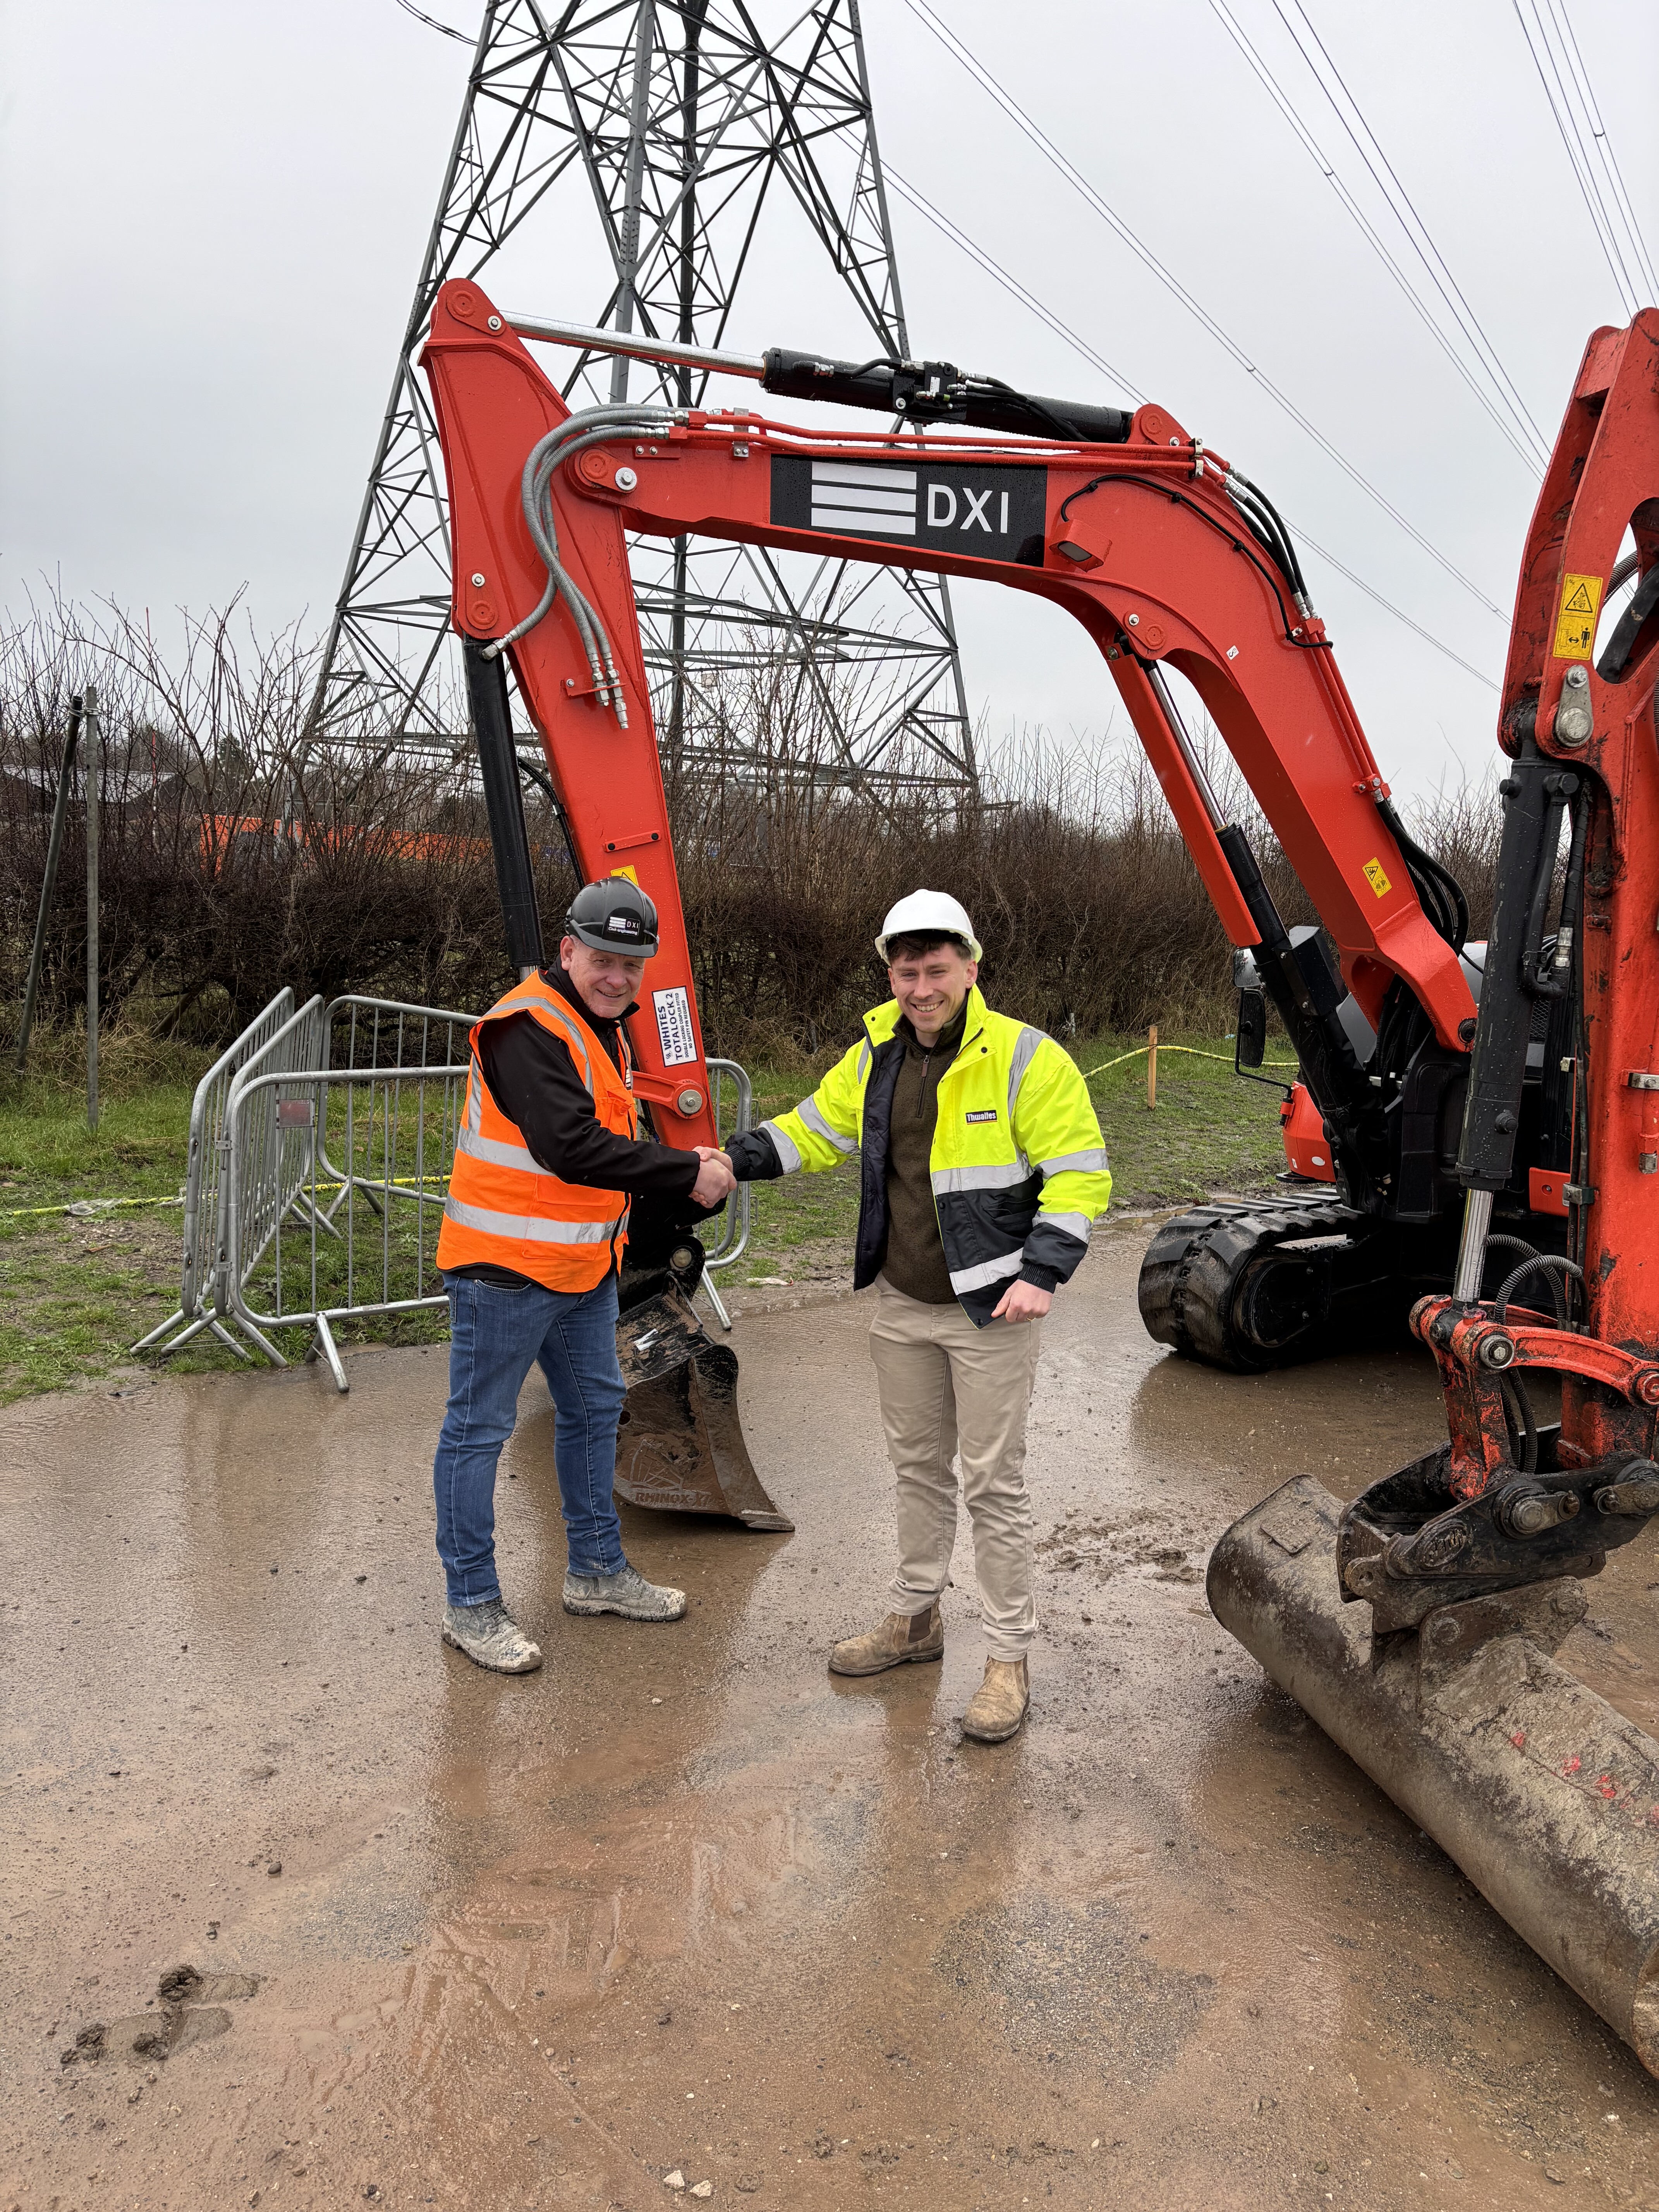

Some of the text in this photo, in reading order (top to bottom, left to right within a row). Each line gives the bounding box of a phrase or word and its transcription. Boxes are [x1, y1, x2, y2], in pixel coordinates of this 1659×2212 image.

[927, 484, 1008, 533] DXI
[658, 1006, 672, 1051] WHITES
[666, 1001, 683, 1060] TOTALOCK
